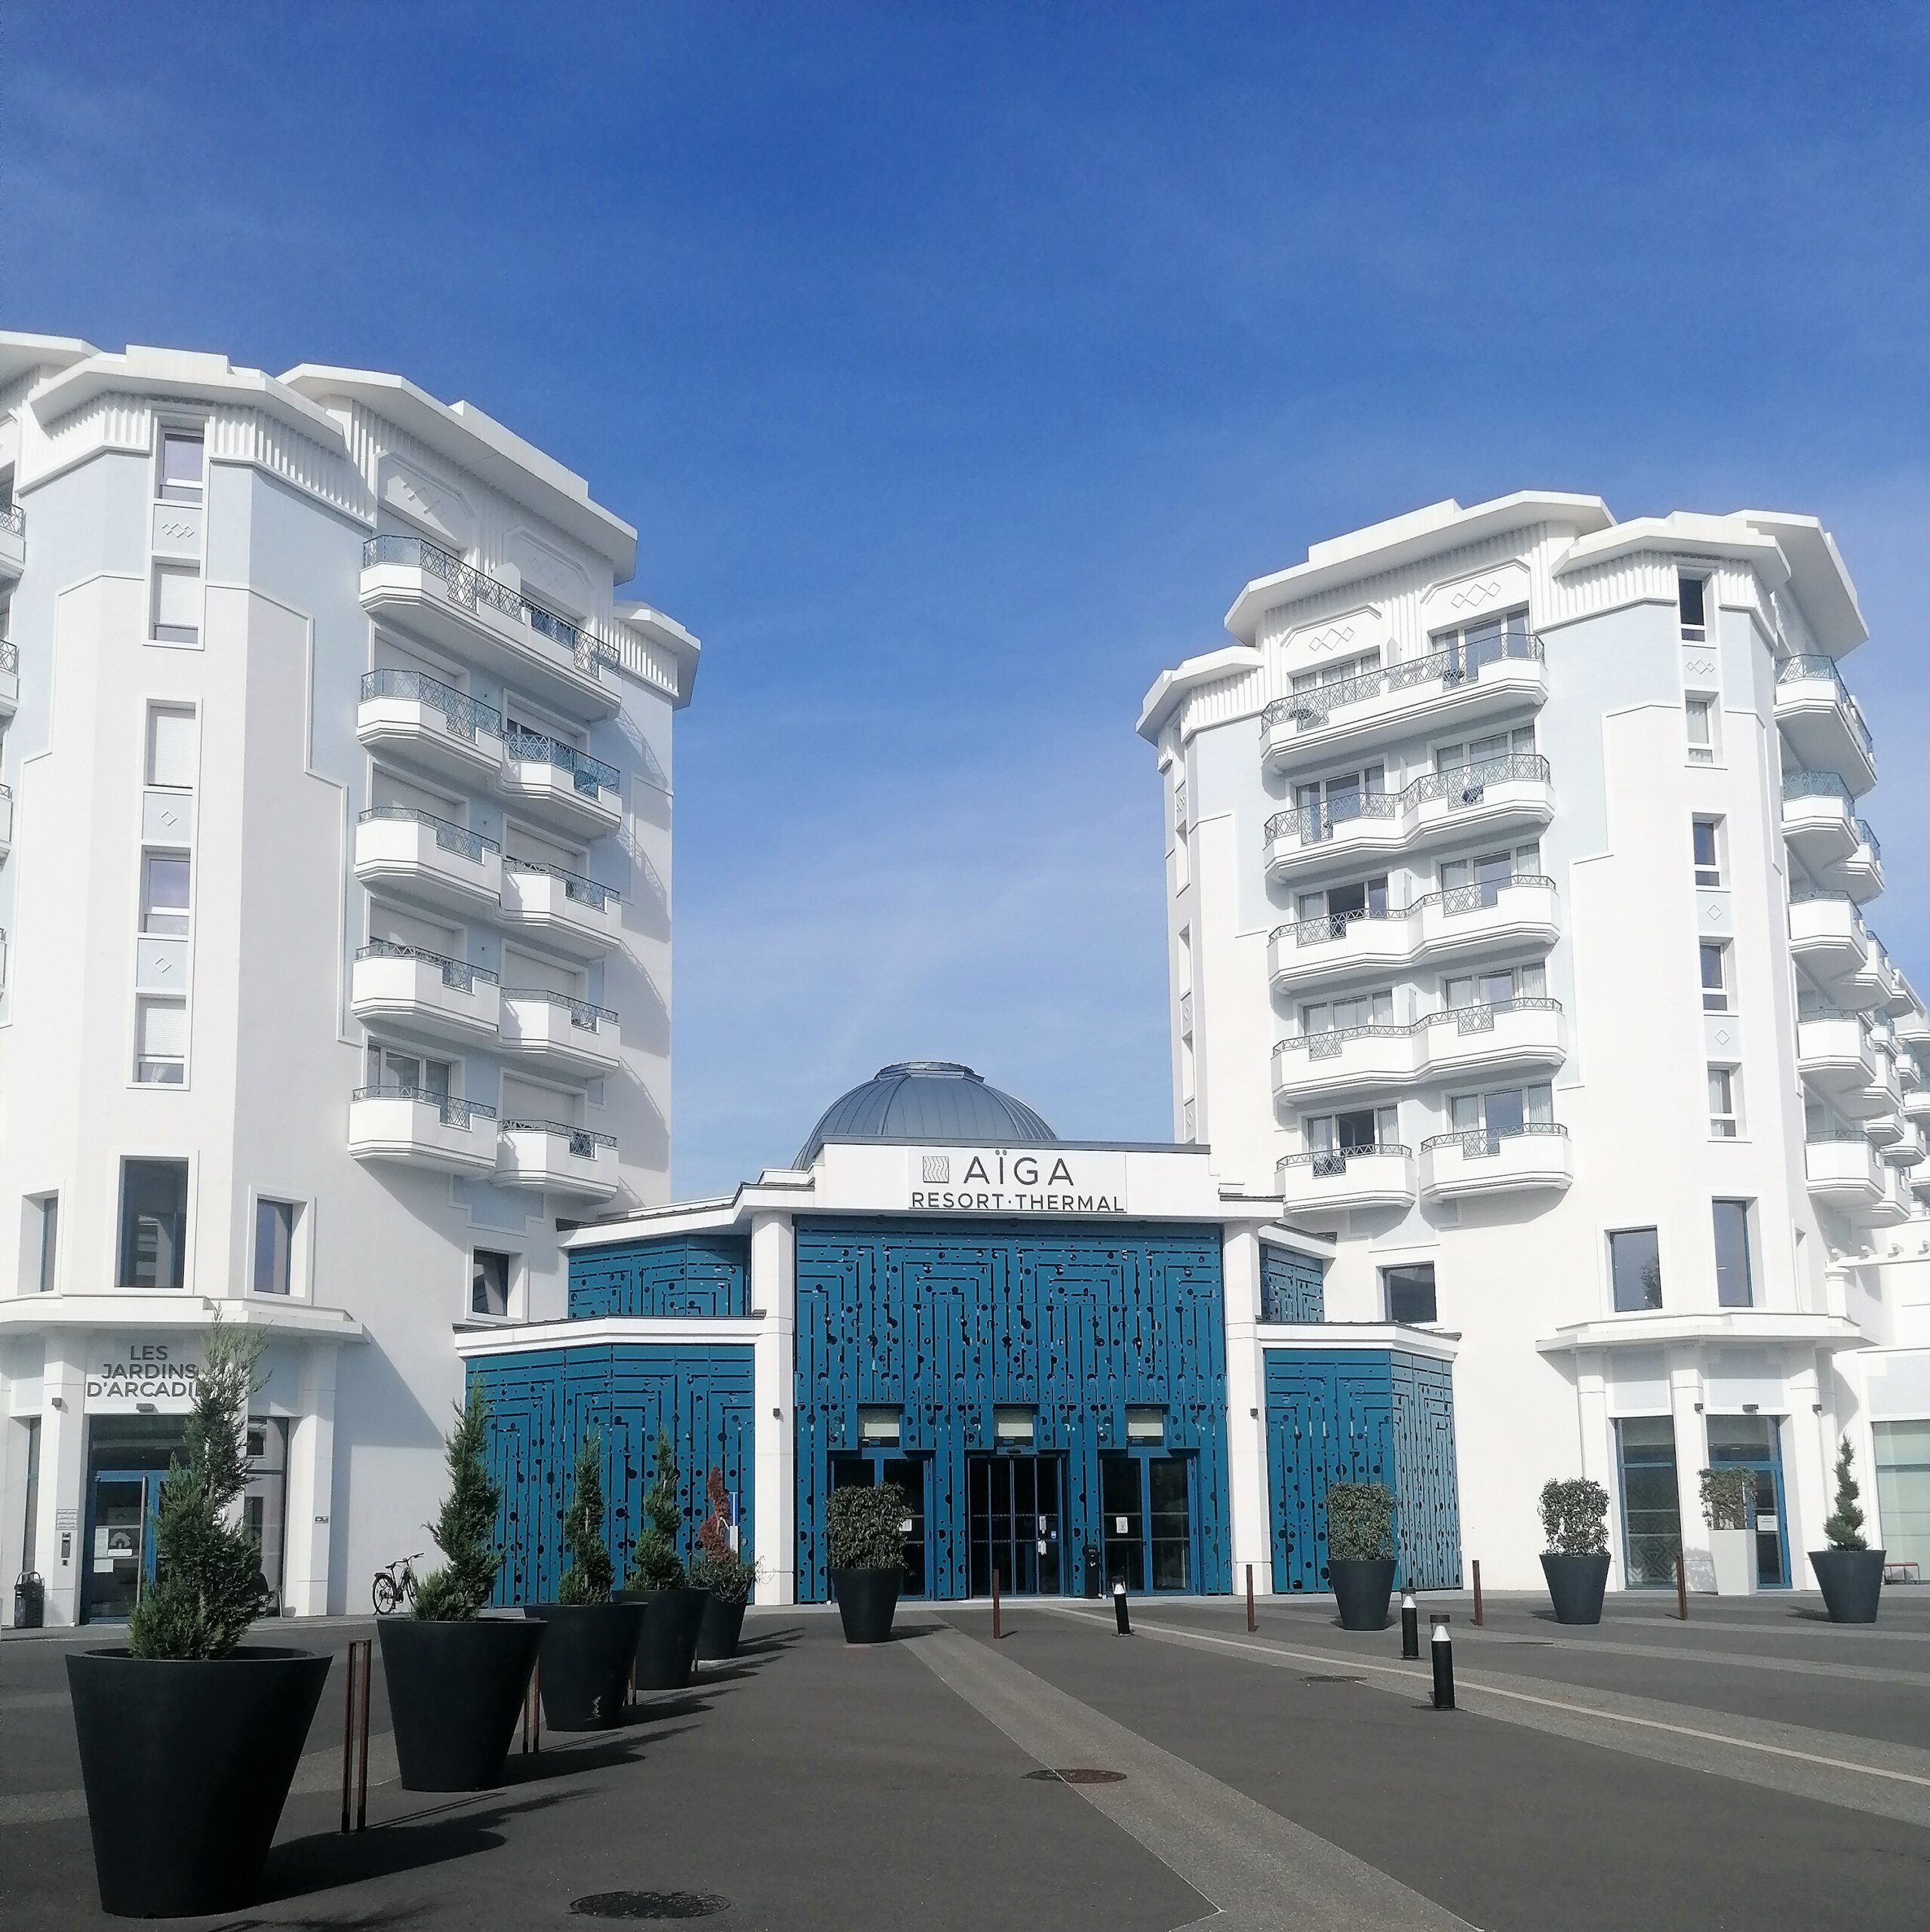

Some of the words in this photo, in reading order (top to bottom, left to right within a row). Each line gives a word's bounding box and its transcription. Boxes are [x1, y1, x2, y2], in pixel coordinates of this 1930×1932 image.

[963, 1149, 1074, 1186] AÏGA
[130, 1345, 168, 1361] LES
[101, 1363, 198, 1380] JARDINS
